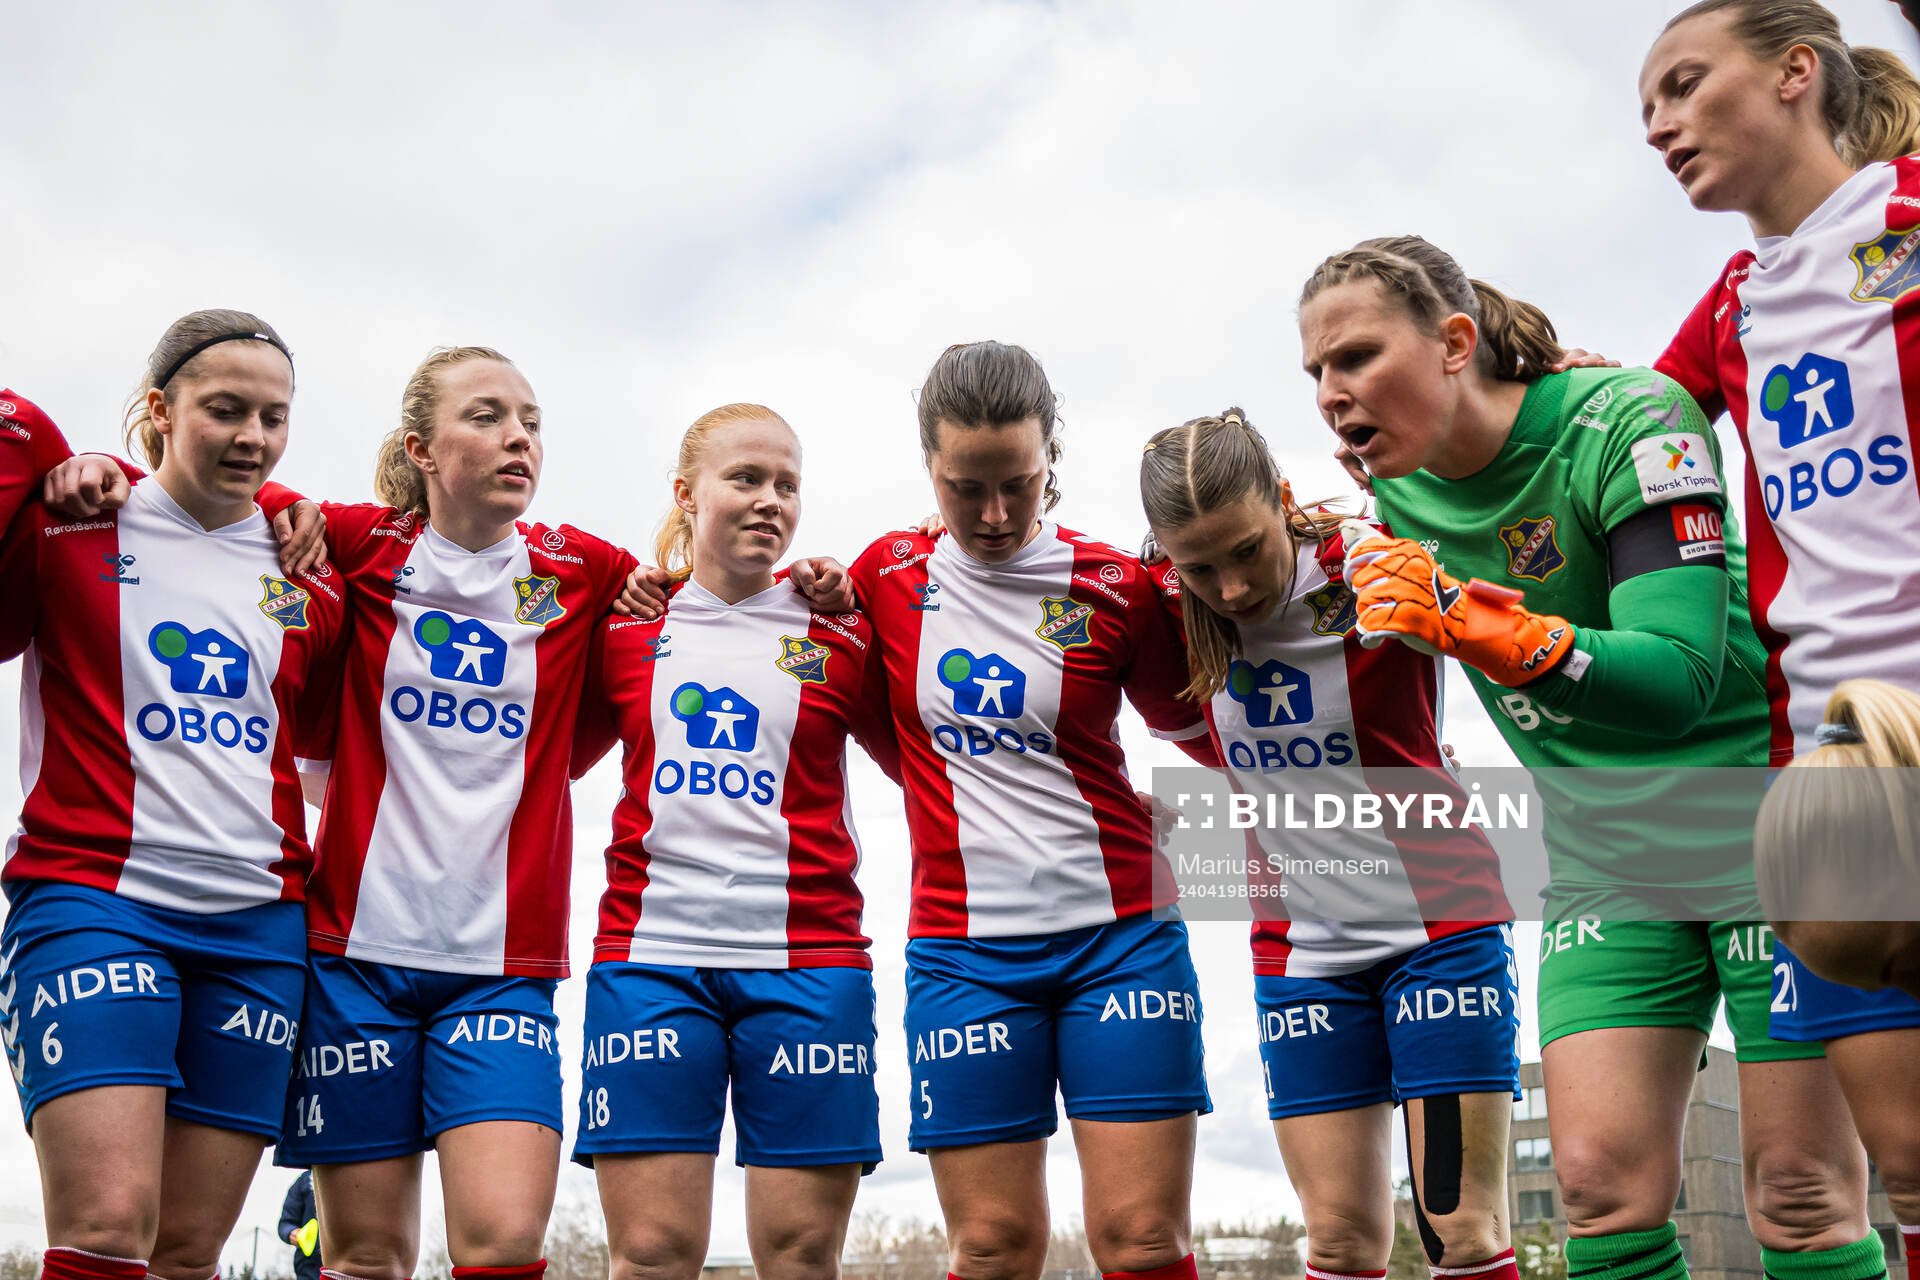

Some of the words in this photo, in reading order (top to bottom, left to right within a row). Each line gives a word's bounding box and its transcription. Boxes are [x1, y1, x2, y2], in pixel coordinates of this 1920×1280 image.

[1647, 479, 1683, 495] Norsk
[1683, 475, 1719, 488] Tipping
[1764, 435, 1908, 522] OBOS
[44, 519, 115, 537] RørosBanken
[1683, 511, 1722, 541] MO
[527, 542, 583, 565] RørosBanken
[879, 552, 932, 577] RørosBanken
[275, 594, 297, 608] LYN
[526, 588, 546, 610] LYN
[1073, 573, 1129, 607] RørosBanken
[812, 613, 866, 650] RørosBanken
[1053, 612, 1078, 630] LYN
[793, 651, 817, 664] LYN
[136, 702, 270, 754] OBOS
[391, 686, 526, 739] OBOS
[933, 724, 1052, 757] OBOS
[1229, 732, 1354, 775] OBOS
[655, 759, 775, 806] OBOS
[31, 962, 160, 1018] AIDER
[1100, 990, 1197, 1023] AIDER
[1396, 986, 1502, 1024] AIDER
[42, 1022, 63, 1065] 6
[447, 1014, 553, 1055] AIDER
[586, 1028, 682, 1071] AIDER
[915, 1022, 1012, 1064] AIDER
[768, 1043, 868, 1076] AIDER
[296, 1094, 324, 1136] 14
[587, 1087, 610, 1130] 18
[920, 1080, 933, 1120] 5
